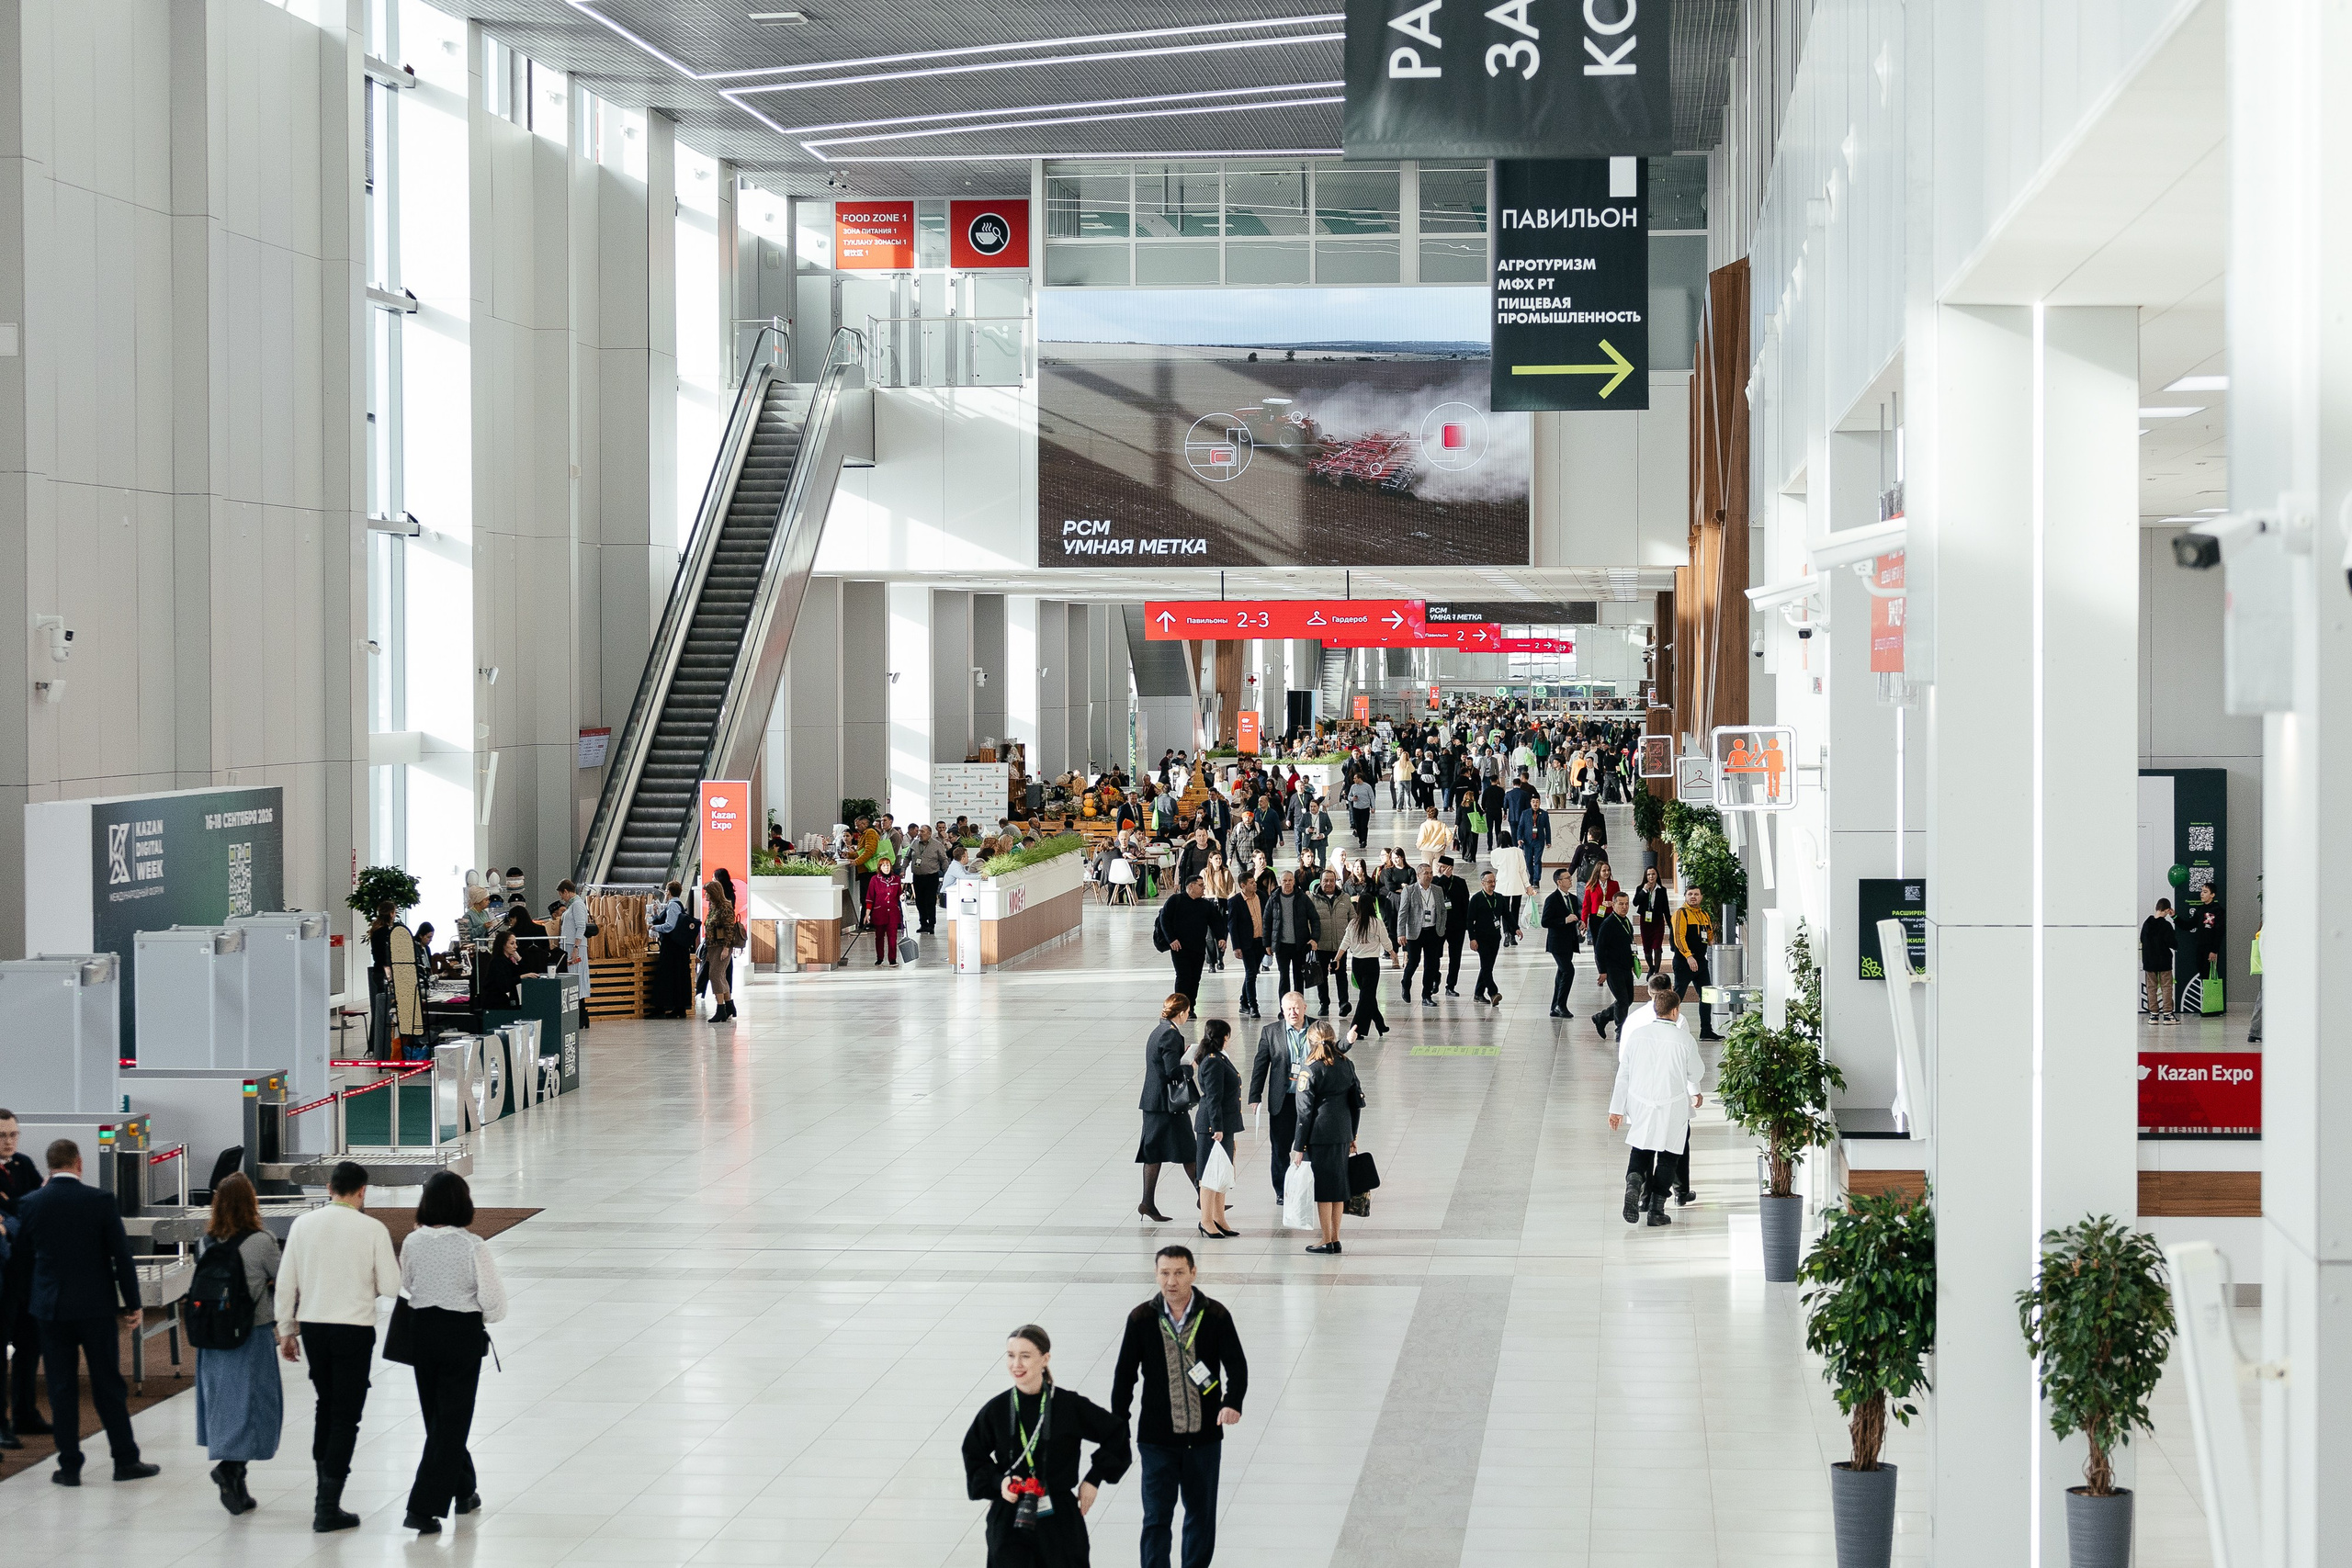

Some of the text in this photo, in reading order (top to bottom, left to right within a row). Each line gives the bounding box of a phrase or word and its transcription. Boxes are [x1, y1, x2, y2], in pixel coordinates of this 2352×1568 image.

[1387, 0, 1442, 78] РА
[1485, 0, 1540, 80] ЗА
[842, 213, 907, 222] FOOD ZONE 1
[1501, 208, 1637, 229] ПАВИЛЬОН
[1498, 258, 1597, 272] АГРОТУРИЗМ
[1498, 278, 1555, 290] МФХ РТ
[1498, 297, 1571, 310] ПИЩЕВАЯ
[1498, 310, 1642, 324] ПРОМЫШЛЕННОСТЬ
[1062, 520, 1111, 536] РСМ
[1063, 538, 1207, 555] УМНАЯ МЕТКА
[1186, 611, 1269, 627] Павильоны 2-3
[1331, 615, 1368, 625] Гардероб
[1457, 631, 1464, 641] 2
[222, 809, 257, 828] СЕНТЯБРЯ
[711, 810, 737, 819] Kazan
[136, 819, 164, 837] KAZAN
[711, 820, 732, 831] Expo
[136, 840, 164, 857] DIGITAL
[136, 859, 164, 881] WEEK
[2157, 1065, 2254, 1086] Kazan Expo
